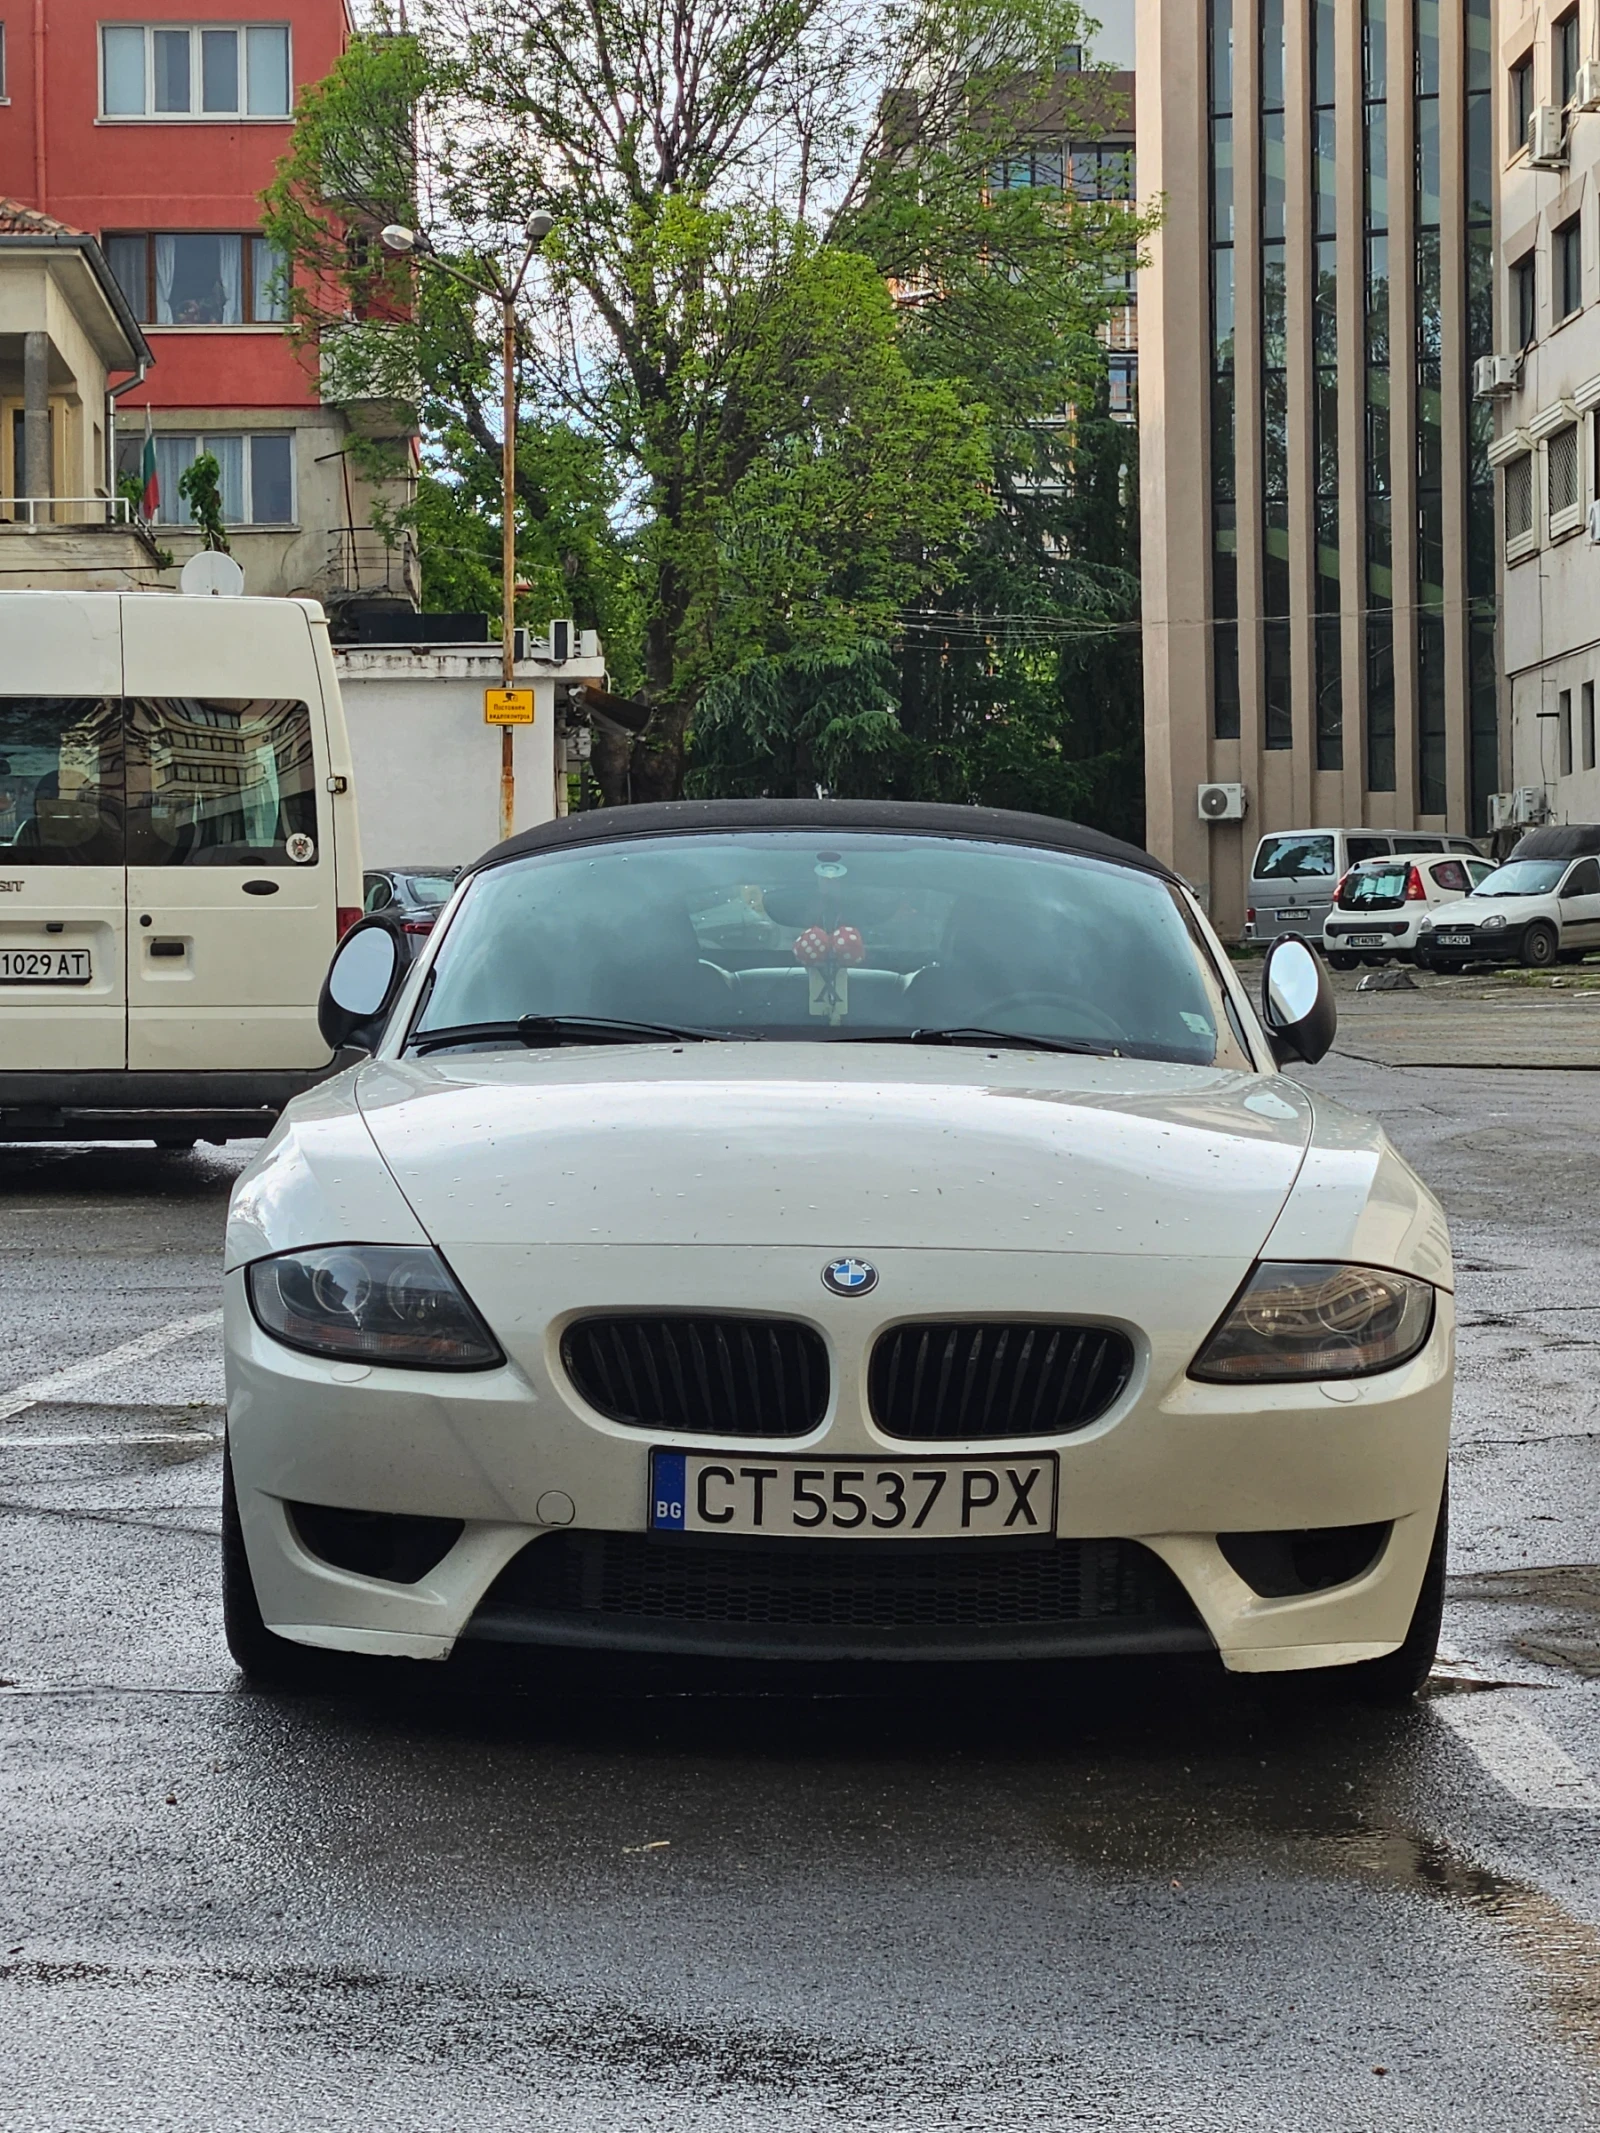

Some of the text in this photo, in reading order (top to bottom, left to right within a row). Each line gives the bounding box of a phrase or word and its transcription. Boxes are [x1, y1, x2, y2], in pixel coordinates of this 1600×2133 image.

[2, 954, 85, 975] 1029 AT
[829, 1259, 872, 1271] BMW
[697, 1466, 1041, 1529] CT 5537 PX
[656, 1501, 682, 1519] BG
